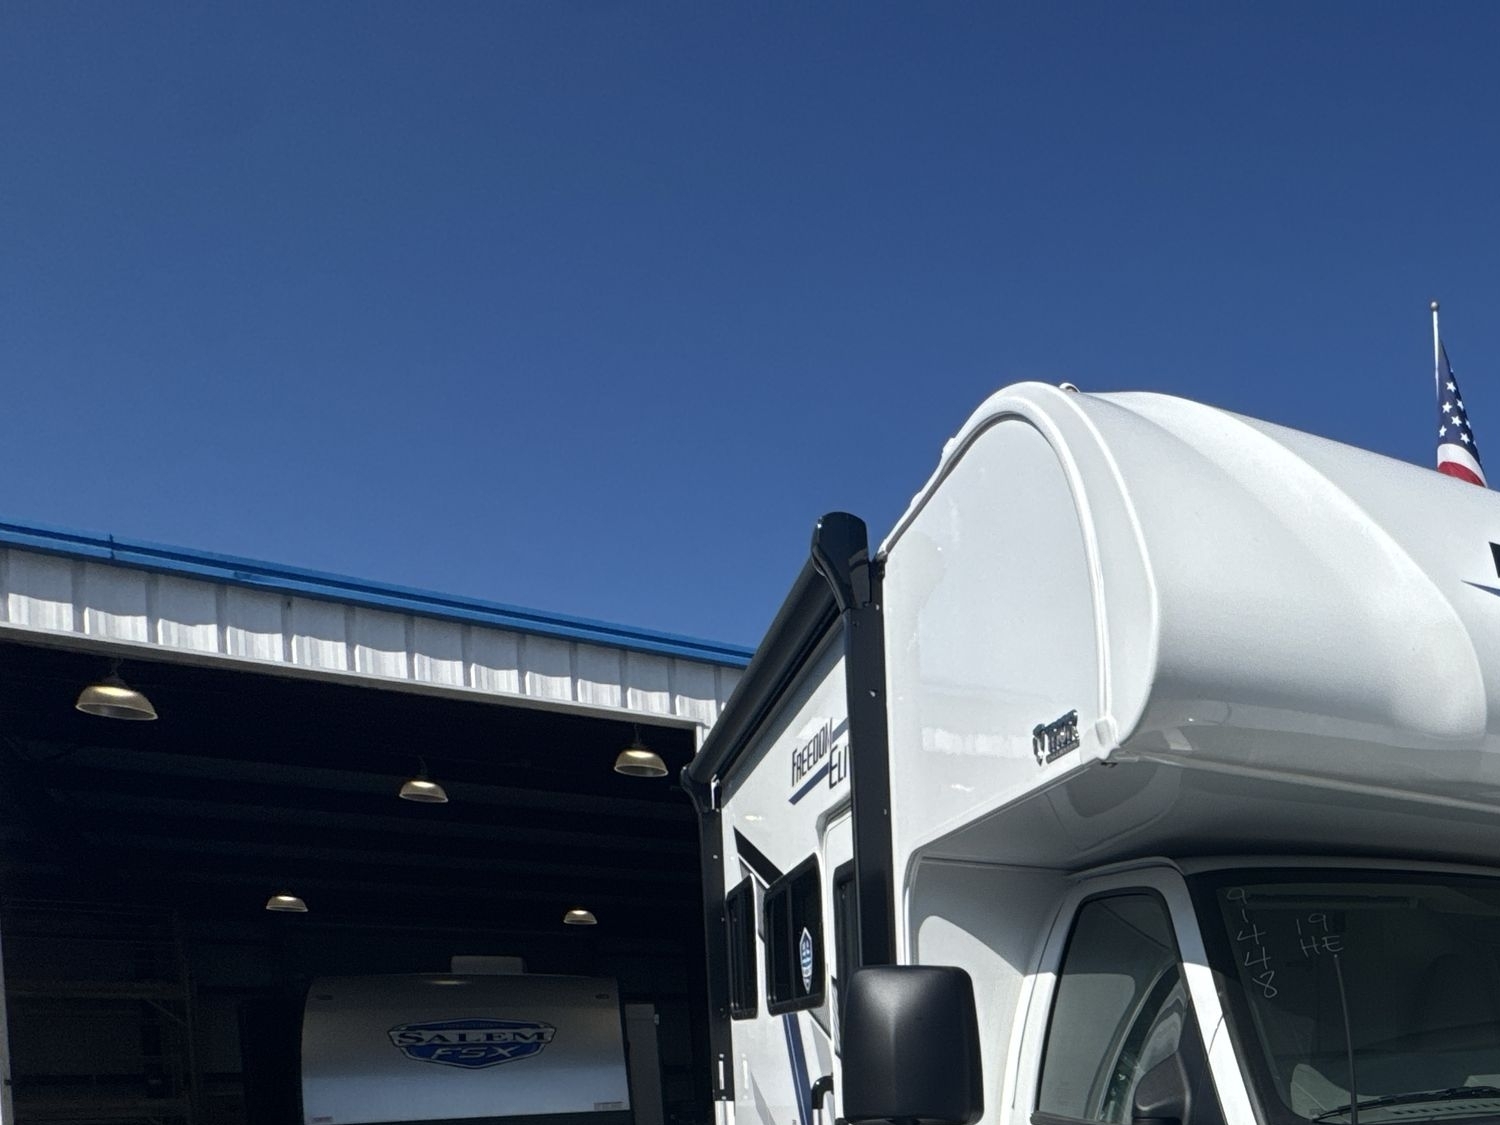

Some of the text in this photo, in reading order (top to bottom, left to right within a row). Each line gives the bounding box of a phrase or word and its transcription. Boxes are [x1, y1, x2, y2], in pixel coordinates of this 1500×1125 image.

[791, 716, 833, 788] FREEDOM
[829, 743, 848, 790] ELI
[1300, 935, 1344, 958] HE
[398, 1031, 547, 1044] SALEM
[431, 1046, 520, 1060] FSX
